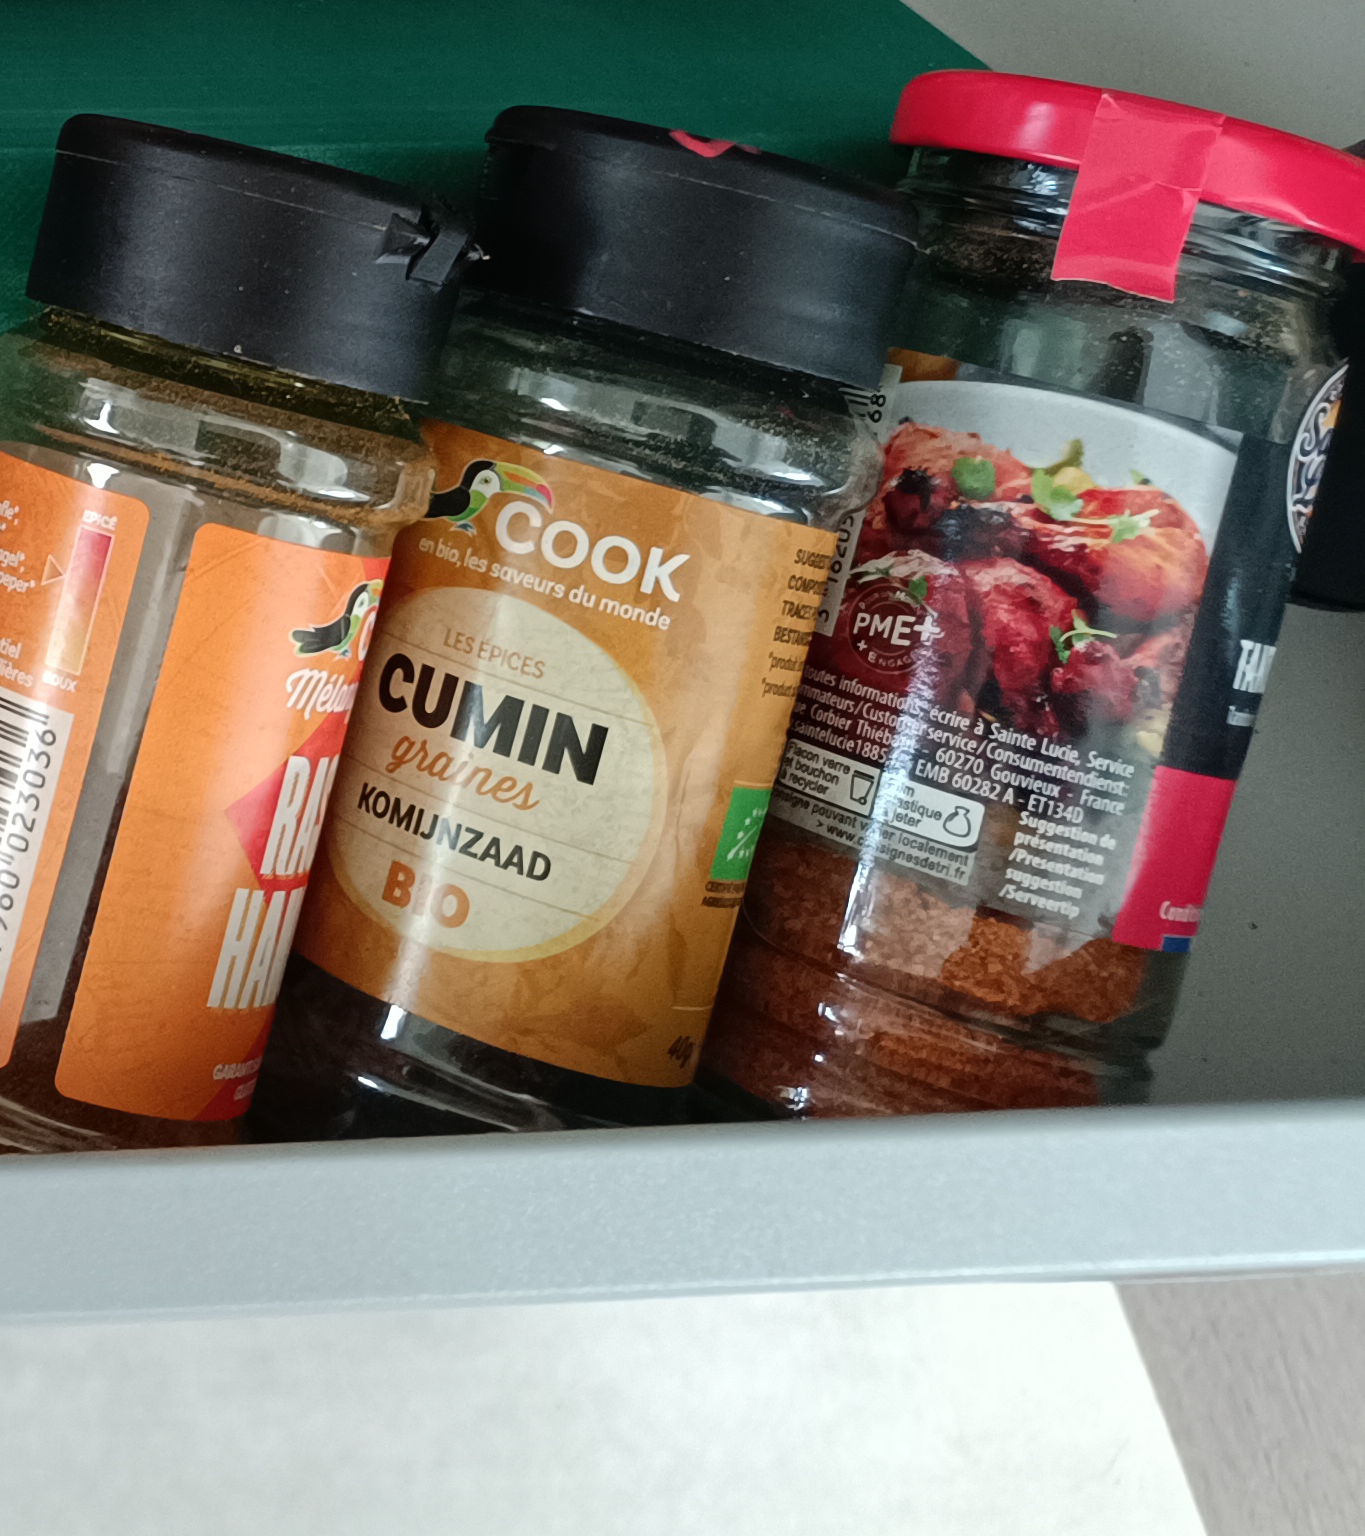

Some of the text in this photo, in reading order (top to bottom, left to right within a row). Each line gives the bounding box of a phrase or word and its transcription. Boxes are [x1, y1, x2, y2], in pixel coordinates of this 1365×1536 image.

[82, 506, 118, 531] EPICÉ
[494, 500, 692, 602] COOK
[418, 536, 673, 631] en bio, les saveurs du monde
[442, 627, 547, 679] LES ÉPICES
[377, 653, 610, 786] CUMIN
[928, 704, 971, 732] écrire
[973, 718, 985, 736] à
[987, 722, 1037, 752] Sainte
[1039, 737, 1083, 767] Lucie,
[1084, 750, 1136, 780] Service
[12, 727, 58, 853] 023036
[386, 734, 541, 812] graines
[786, 740, 851, 776] Flacon verre
[787, 768, 830, 798] recycler
[794, 757, 840, 787] bouchon
[808, 704, 1125, 817] Corbier 60270 Gouvieux France
[913, 760, 1085, 825] EMB 60282 A ET134D
[357, 781, 552, 883] KOMIJNZAAD
[810, 801, 969, 867] pouvant localement
[1013, 827, 1105, 868] présentation
[1018, 809, 1117, 851] Suggestion de
[380, 858, 471, 928] BIO
[1004, 865, 1083, 902] suggestion
